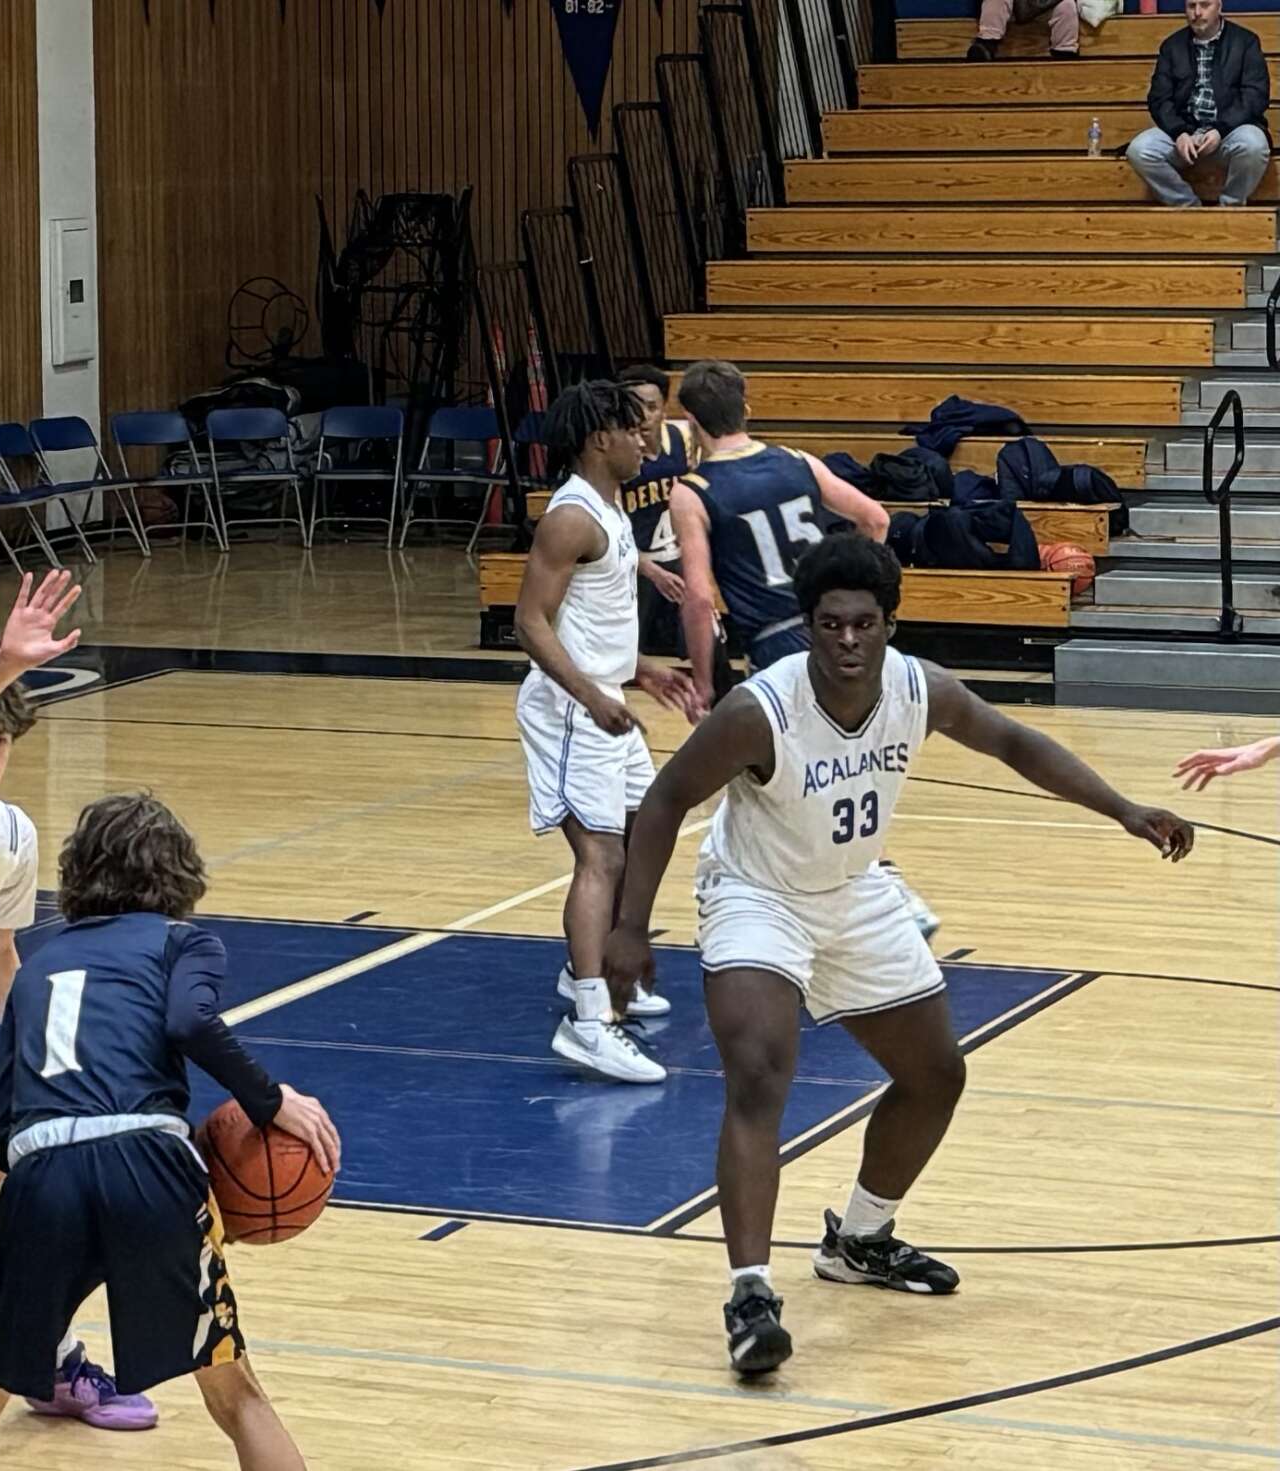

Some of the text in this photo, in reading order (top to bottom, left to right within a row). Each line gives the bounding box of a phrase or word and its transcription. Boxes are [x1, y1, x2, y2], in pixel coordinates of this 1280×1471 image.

[803, 742, 908, 798] ACALANES
[832, 790, 878, 844] 33
[41, 969, 87, 1078] 1
